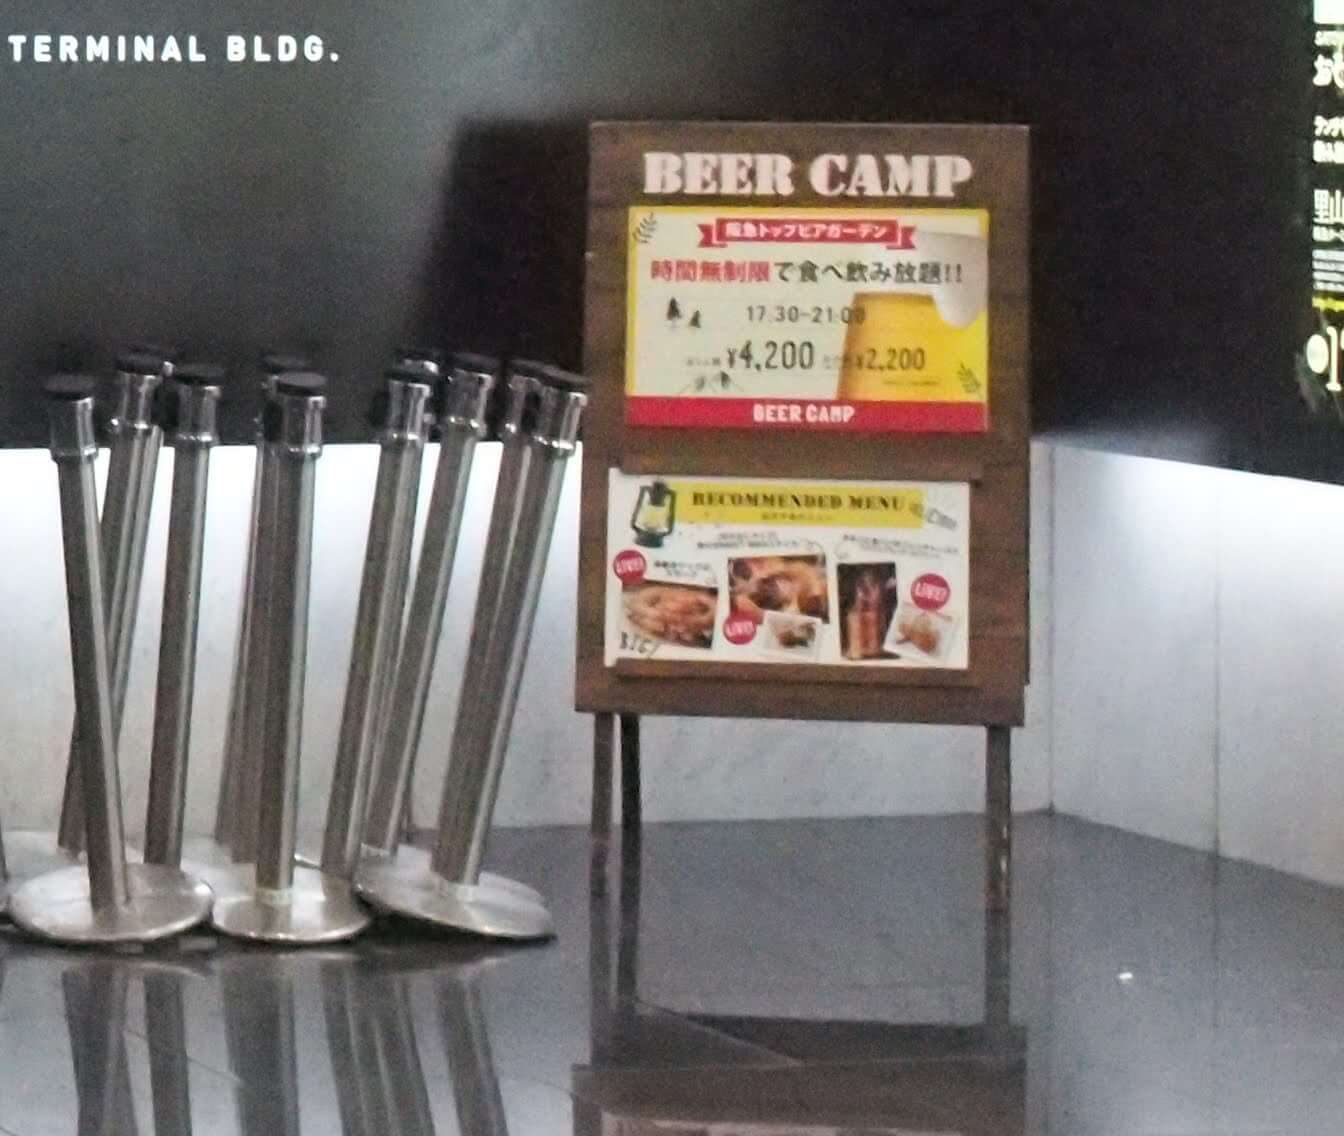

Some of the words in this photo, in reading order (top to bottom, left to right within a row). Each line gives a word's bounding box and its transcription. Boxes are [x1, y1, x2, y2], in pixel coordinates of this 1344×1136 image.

[8, 34, 207, 63] TERMINAL
[226, 34, 340, 63] BLDG.
[642, 151, 794, 197] BEER
[809, 152, 974, 198] CAMP
[725, 221, 888, 241] 阪急トップビアガーデン
[726, 339, 815, 372] ¥4,200
[856, 347, 926, 372] ¥2,200
[753, 403, 802, 423] BEER
[805, 403, 855, 423] CAMP
[692, 491, 843, 510] RECOMMENDED
[848, 495, 905, 511] MENU
